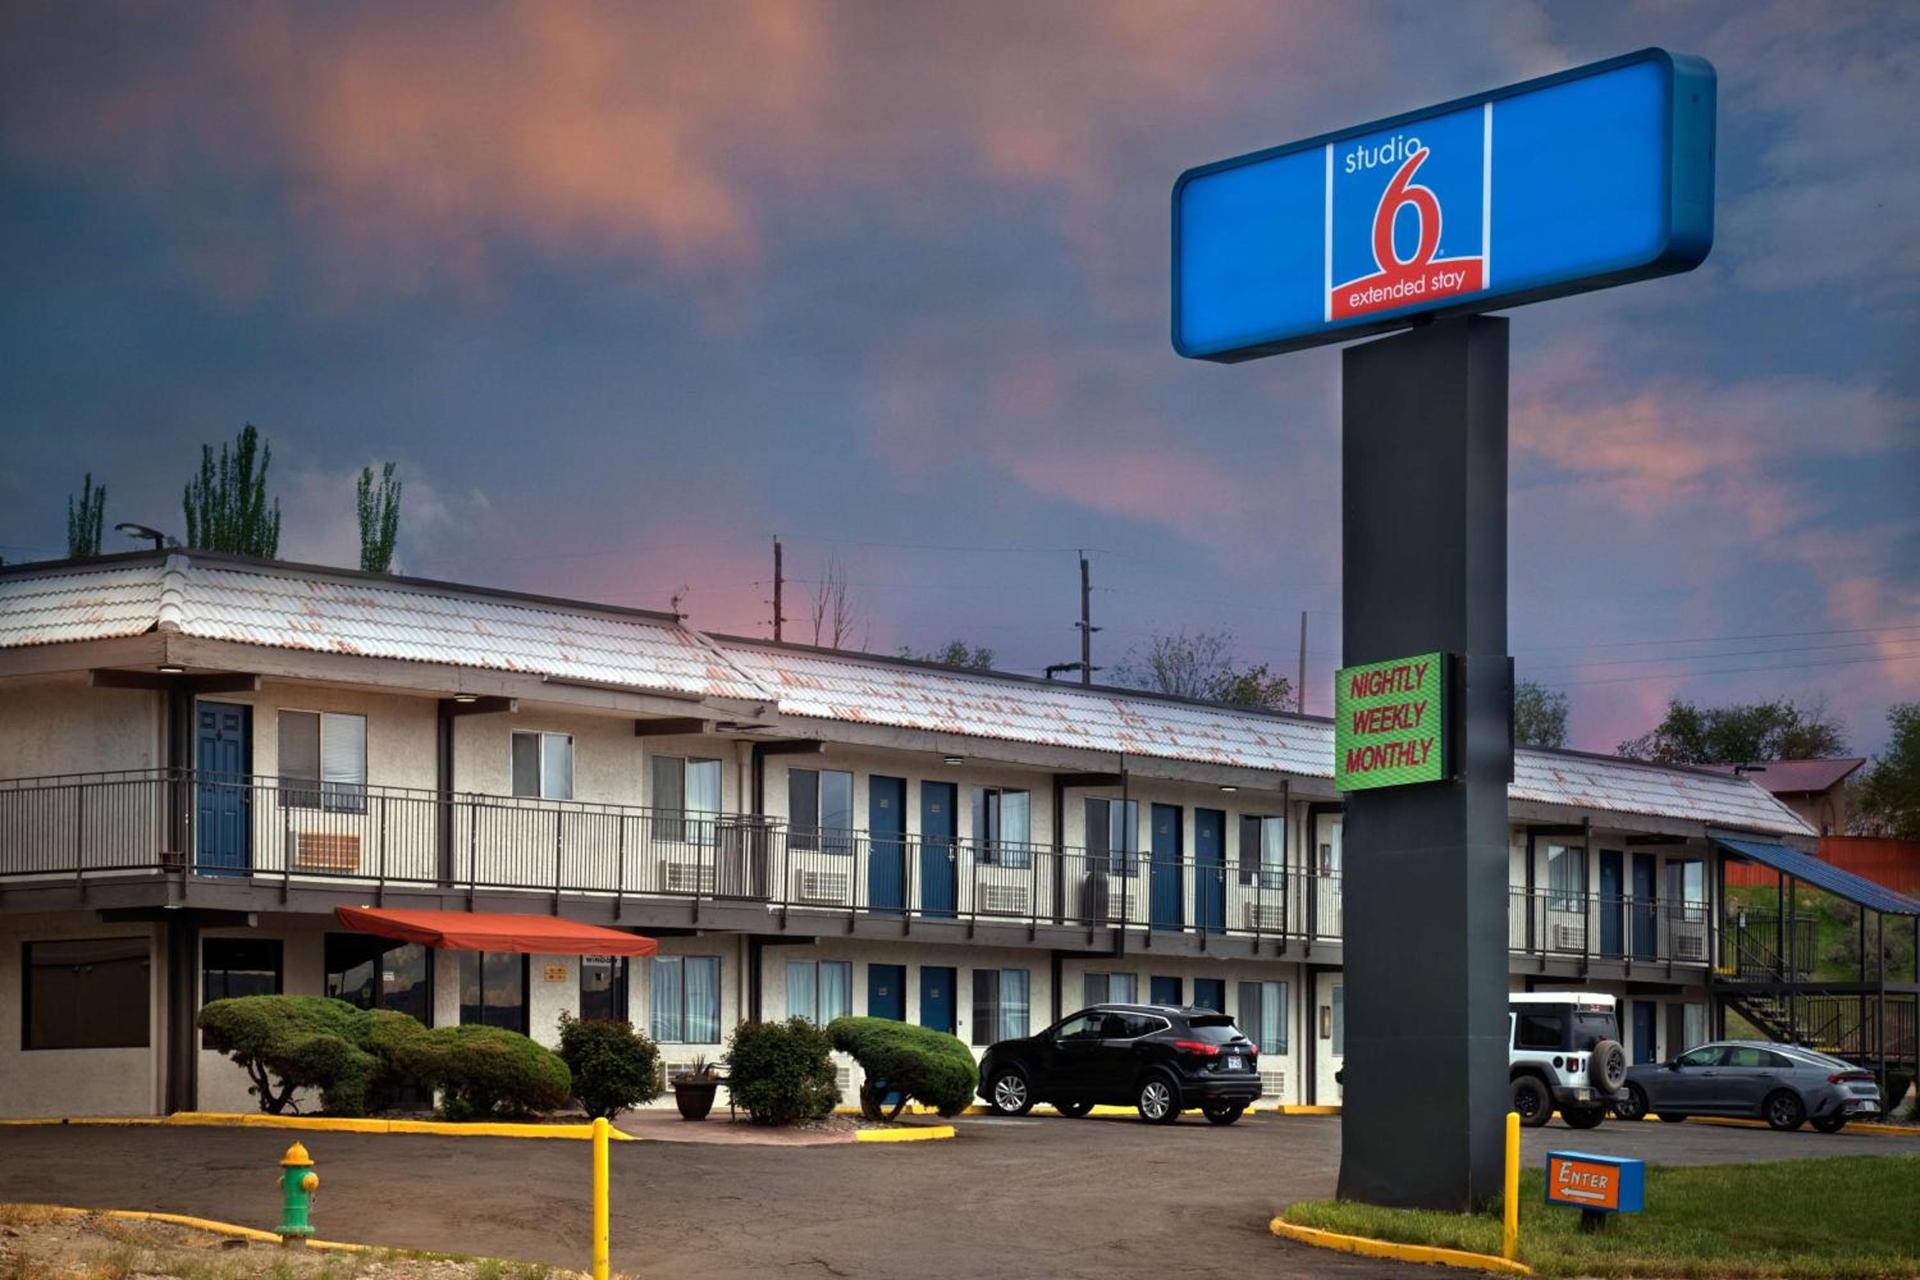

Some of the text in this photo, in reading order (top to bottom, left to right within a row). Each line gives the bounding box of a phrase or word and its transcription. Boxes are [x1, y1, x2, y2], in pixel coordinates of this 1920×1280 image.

[1345, 135, 1422, 173] studio
[1372, 147, 1442, 272] 6
[1350, 271, 1465, 307] extended stay
[1350, 662, 1428, 699] NIGHTLY
[1353, 700, 1427, 735] WEEKLY
[1346, 737, 1434, 773] MONTHLY
[1559, 1161, 1608, 1188] ENTER
